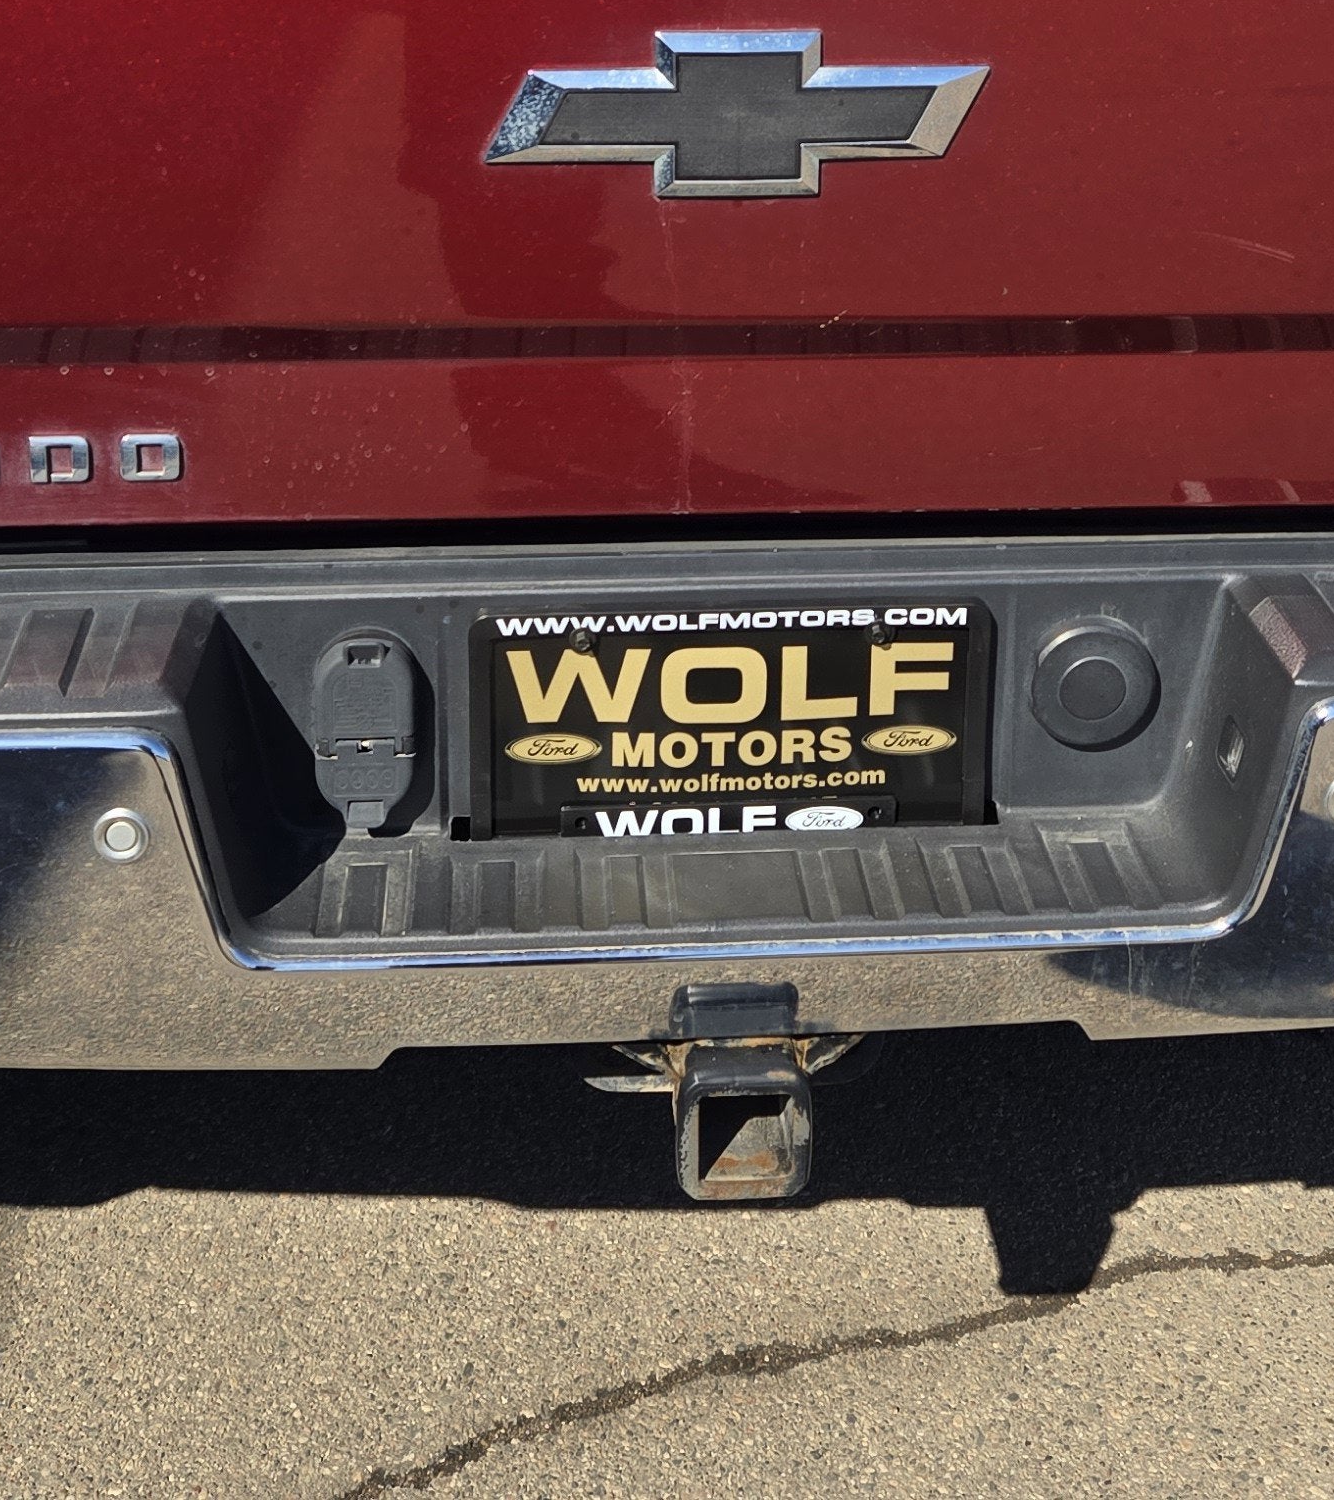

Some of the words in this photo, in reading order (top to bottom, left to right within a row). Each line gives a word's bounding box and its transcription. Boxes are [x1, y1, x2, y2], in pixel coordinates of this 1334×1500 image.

[505, 642, 954, 724] WOLF
[526, 735, 581, 757] Ford
[611, 726, 853, 768] MOTORS
[876, 728, 934, 749] Ford
[576, 767, 886, 793] www.wolfmotors.com
[594, 805, 778, 838] WOLF
[801, 811, 846, 829] Ford
